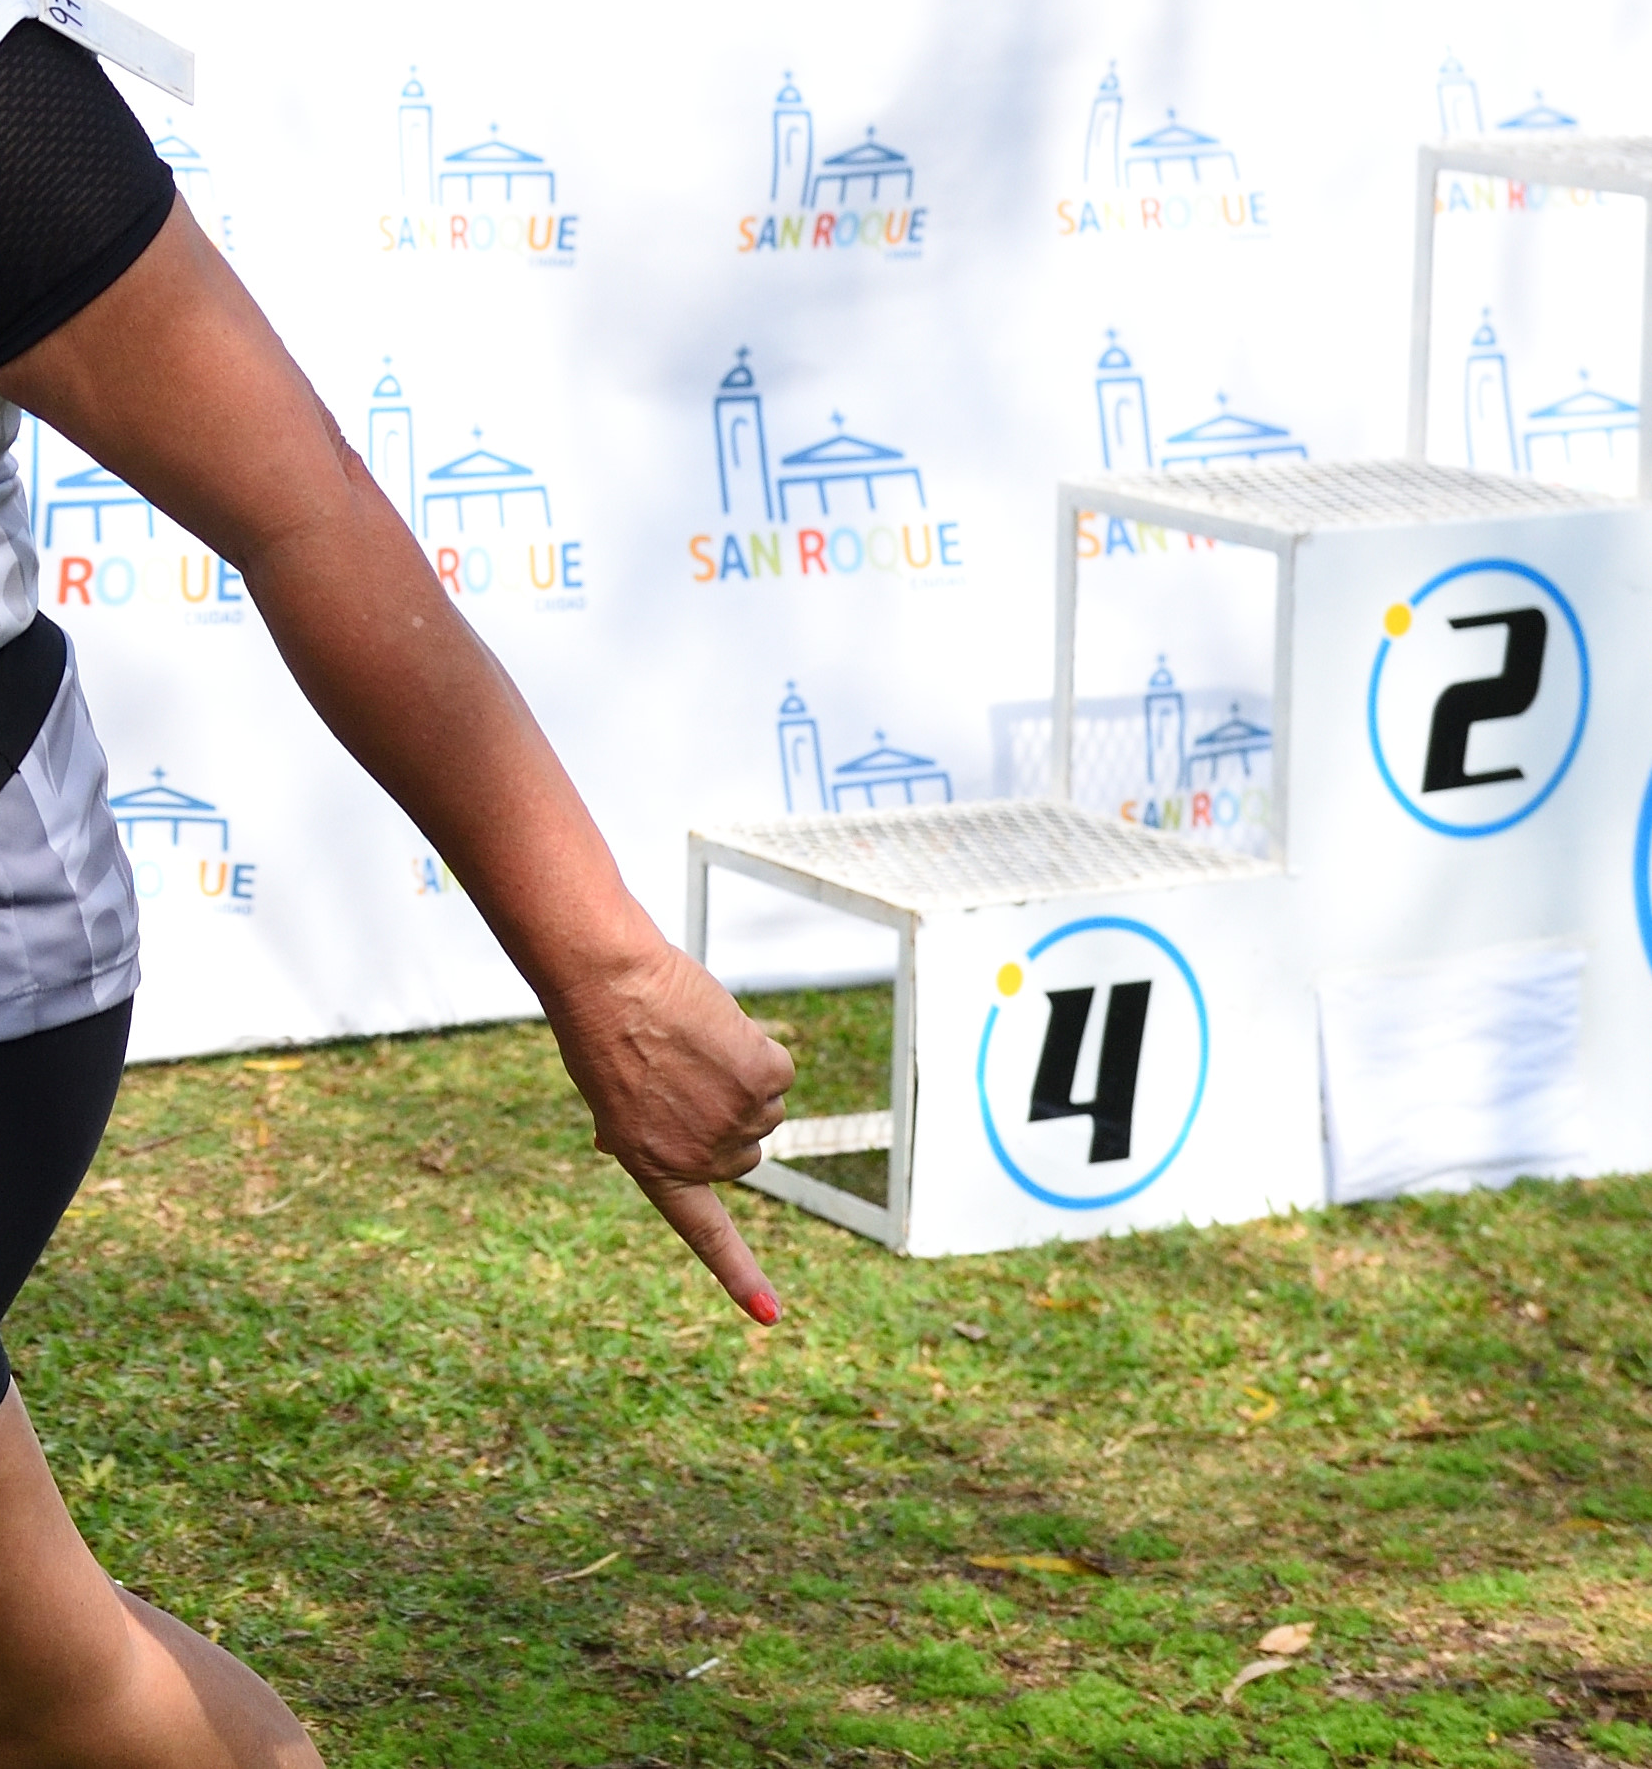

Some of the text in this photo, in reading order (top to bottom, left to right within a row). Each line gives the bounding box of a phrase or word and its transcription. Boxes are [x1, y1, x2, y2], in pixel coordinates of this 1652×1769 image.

[378, 215, 438, 253] SAN
[737, 205, 930, 254] SAN ROQUE
[1056, 199, 1126, 236] SAN
[687, 520, 964, 584] SAN ROQUE
[1422, 607, 1548, 793] 2
[1191, 787, 1272, 832] ROQ
[1027, 980, 1152, 1165] 4
